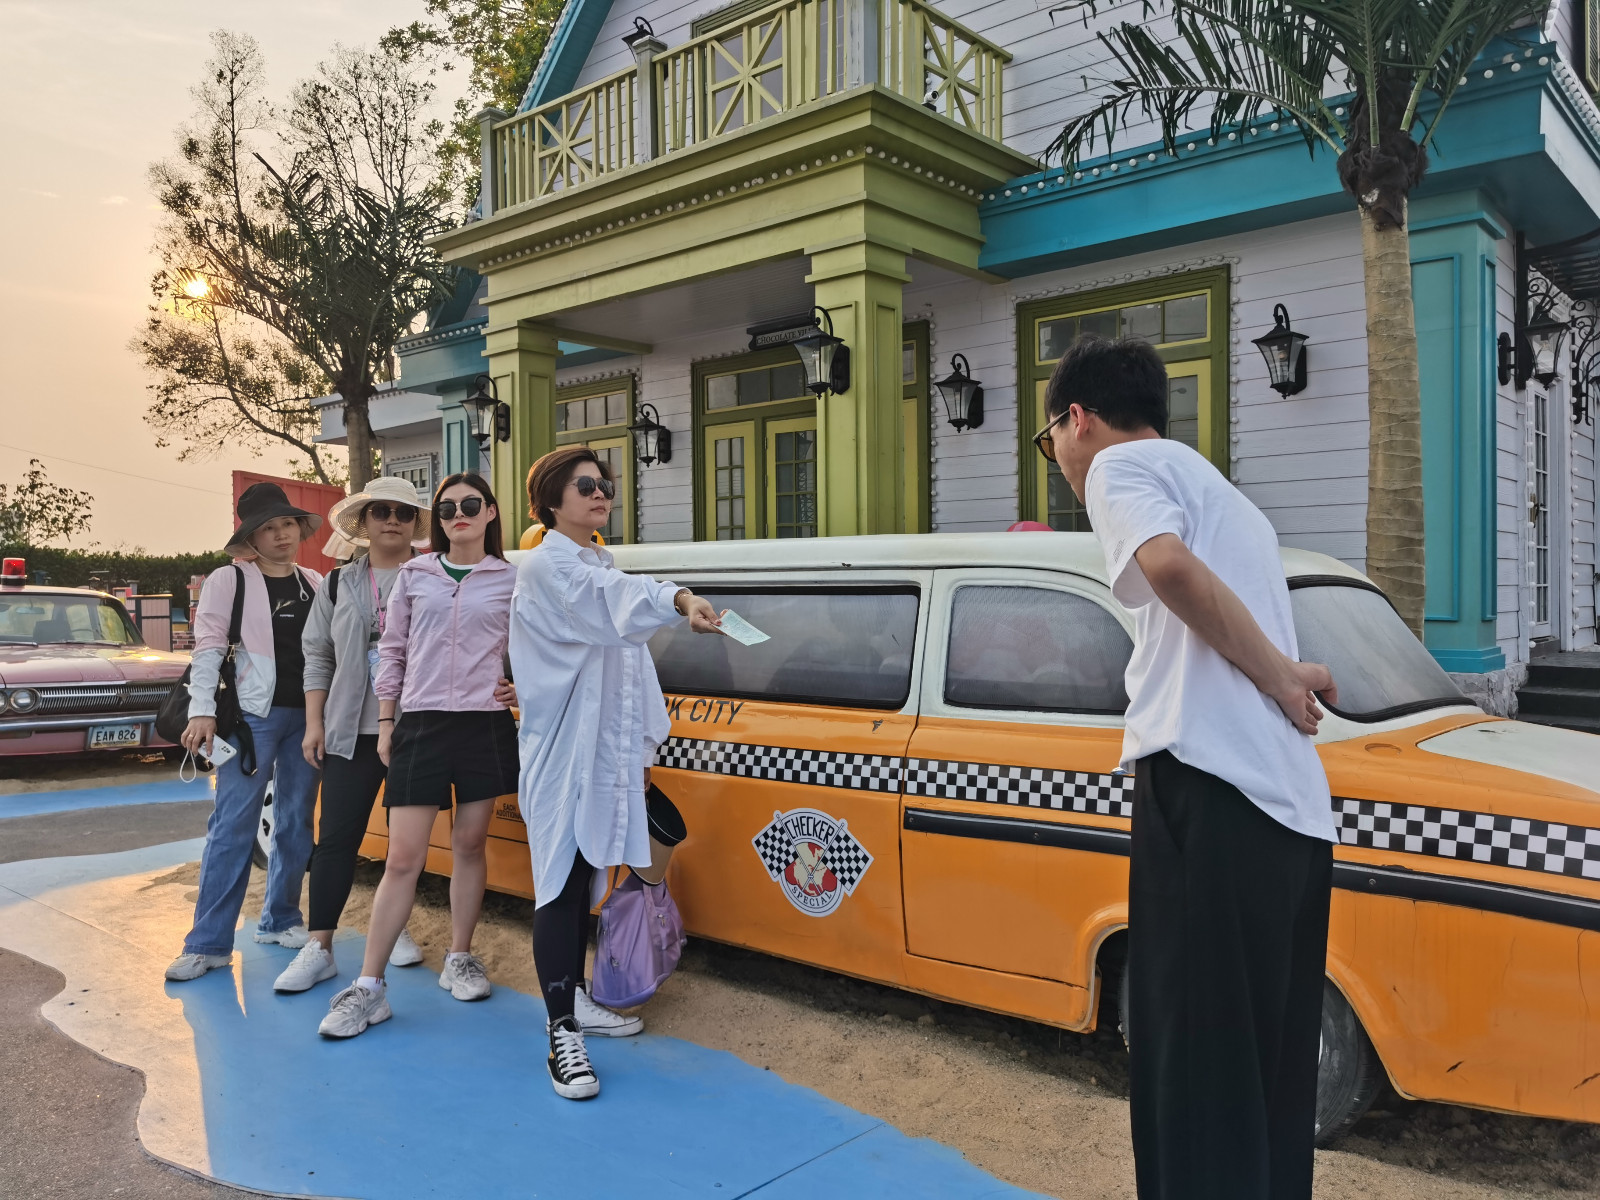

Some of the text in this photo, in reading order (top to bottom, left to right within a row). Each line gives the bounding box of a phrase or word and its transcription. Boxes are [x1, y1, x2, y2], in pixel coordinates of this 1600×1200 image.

[755, 331, 796, 345] CHOCOLATE
[689, 698, 744, 725] CITY
[95, 729, 136, 742] EAW 826
[784, 815, 835, 845] CHECKER
[791, 885, 832, 907] SPECIAL
